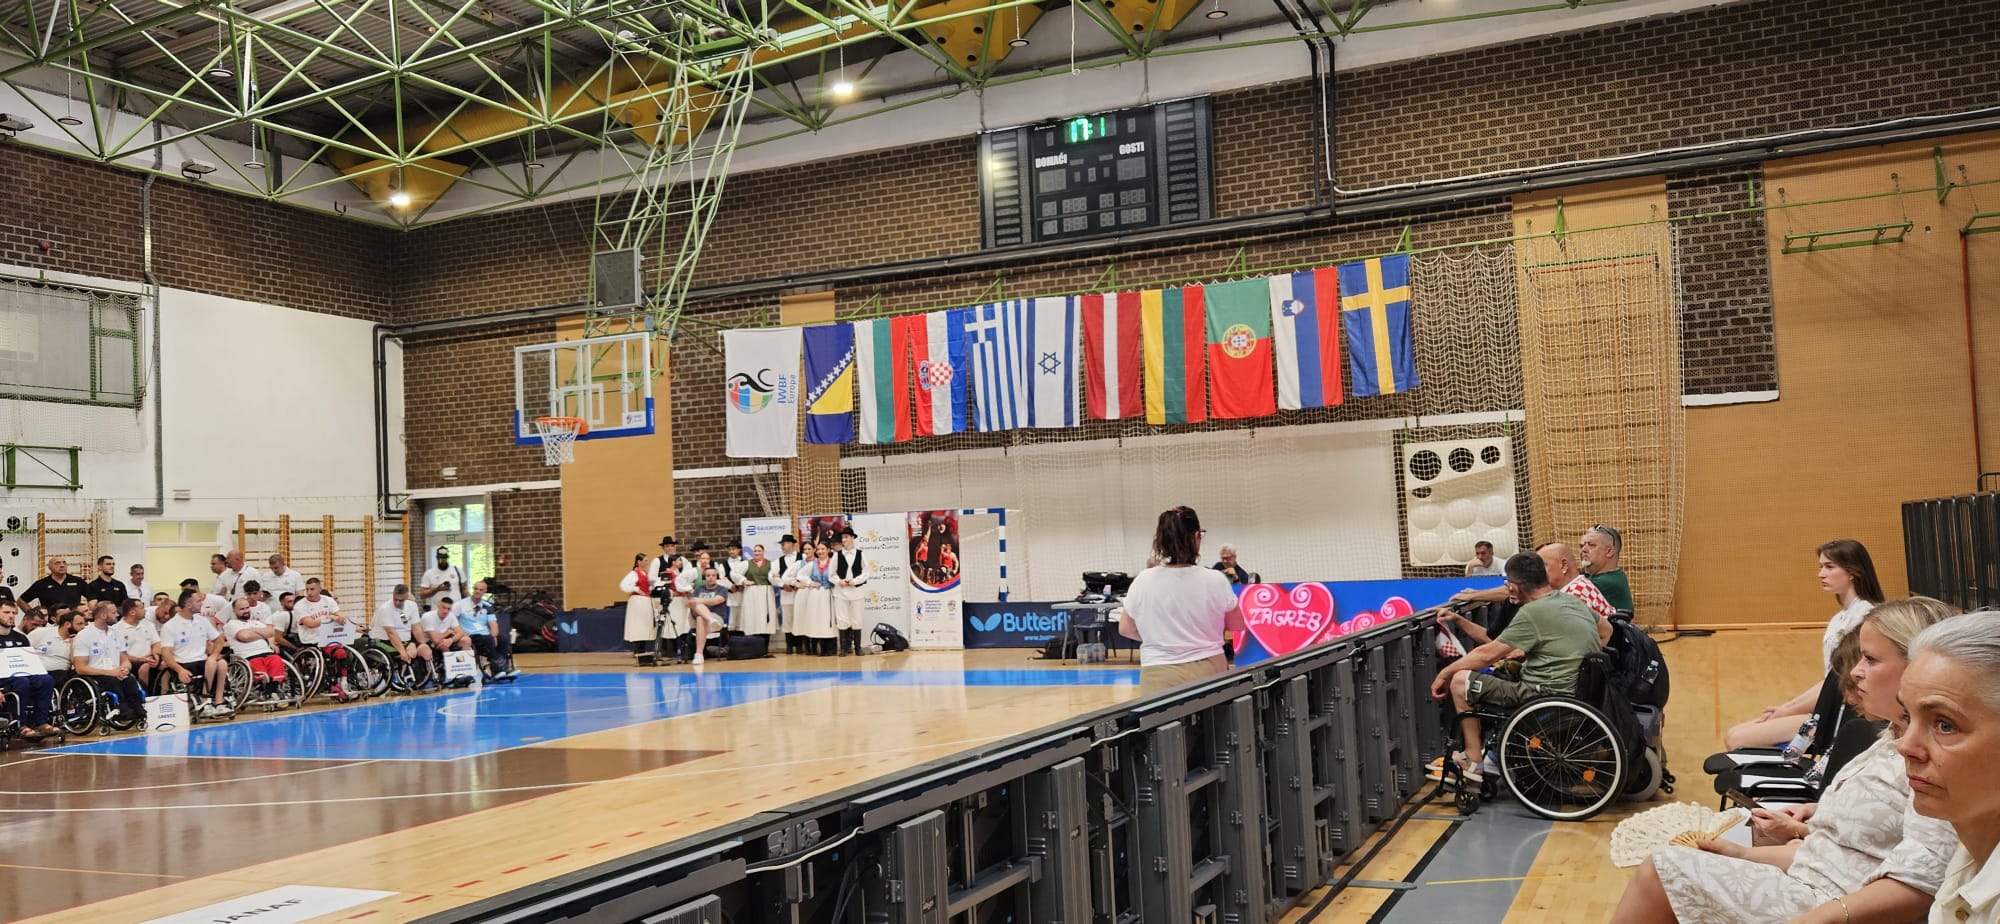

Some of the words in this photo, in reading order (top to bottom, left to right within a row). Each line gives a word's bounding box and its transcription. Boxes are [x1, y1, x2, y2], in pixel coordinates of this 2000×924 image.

[1035, 152, 1068, 168] DOMAĆI
[1119, 141, 1145, 155] GOSTI
[777, 374, 787, 404] IWBF
[787, 374, 797, 404] Europe
[1003, 611, 1071, 632] Butterfl
[1249, 607, 1323, 632] ZAGREB
[212, 898, 303, 924] JANAF
